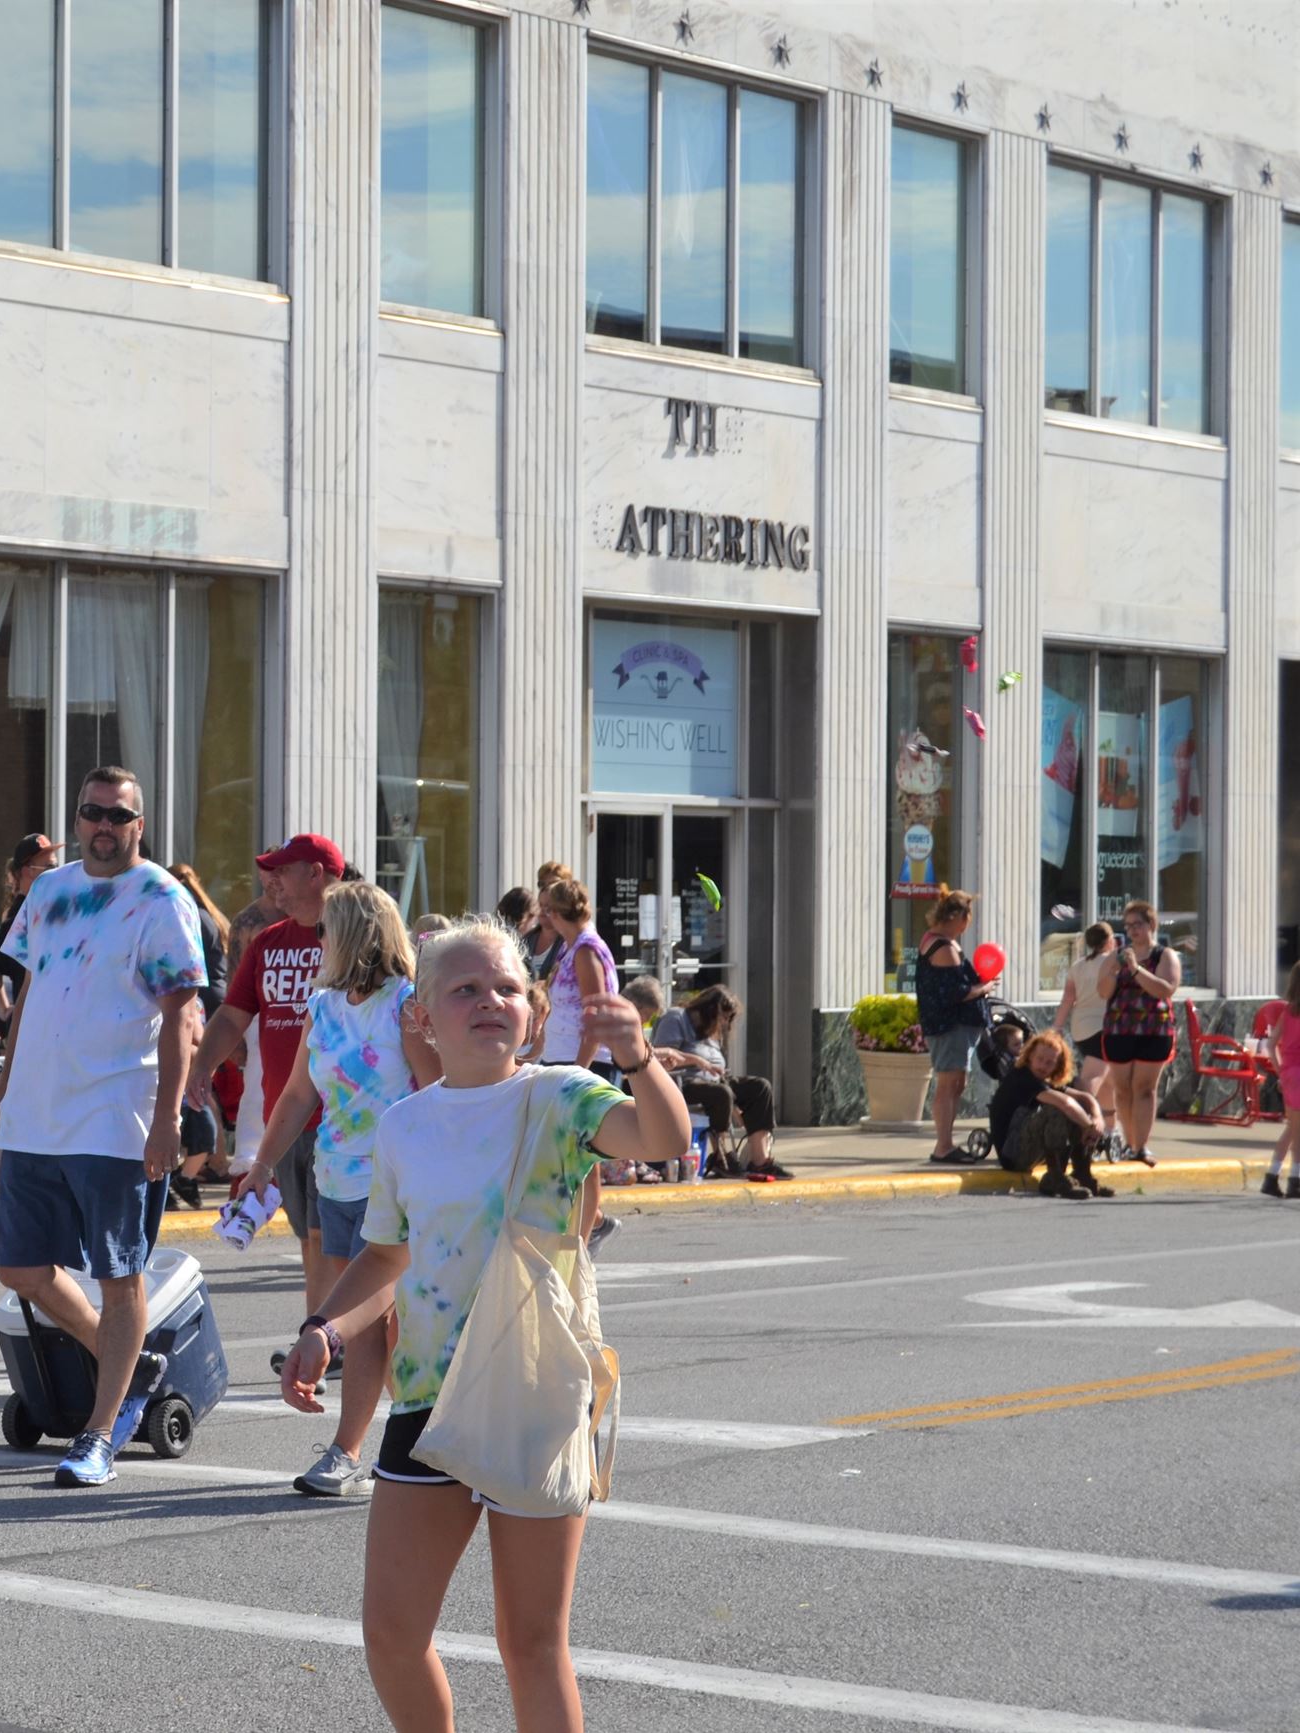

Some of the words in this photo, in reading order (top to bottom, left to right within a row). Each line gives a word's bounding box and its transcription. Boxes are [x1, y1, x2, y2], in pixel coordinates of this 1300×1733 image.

[632, 644, 661, 663] CLINIC
[673, 647, 690, 665] SPA
[593, 718, 676, 751] WISHING
[679, 720, 728, 754] WELL
[1097, 895, 1123, 920] UICE
[264, 947, 324, 968] VANCR
[263, 968, 314, 1002] REH
